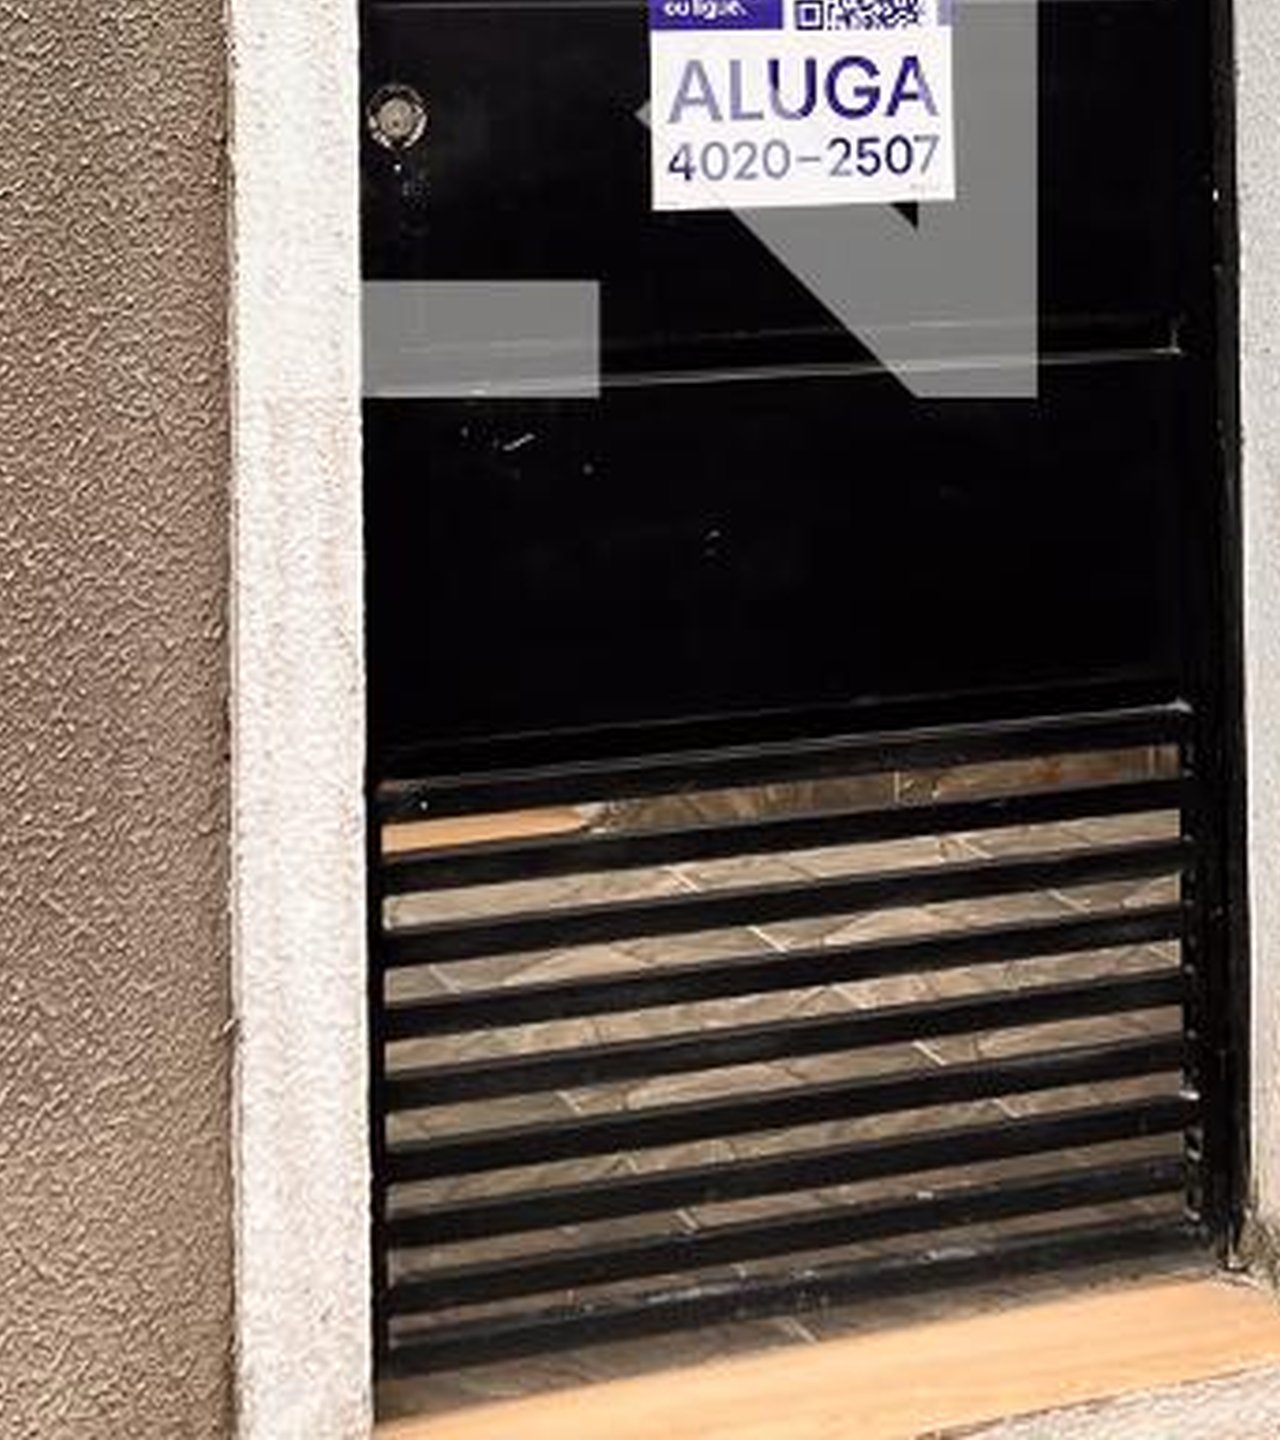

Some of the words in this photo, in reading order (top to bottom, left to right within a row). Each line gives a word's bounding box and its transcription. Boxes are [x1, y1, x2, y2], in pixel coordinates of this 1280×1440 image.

[664, 0, 690, 16] ou
[667, 54, 940, 123] ALUGA
[668, 134, 940, 182] 4020-2507
